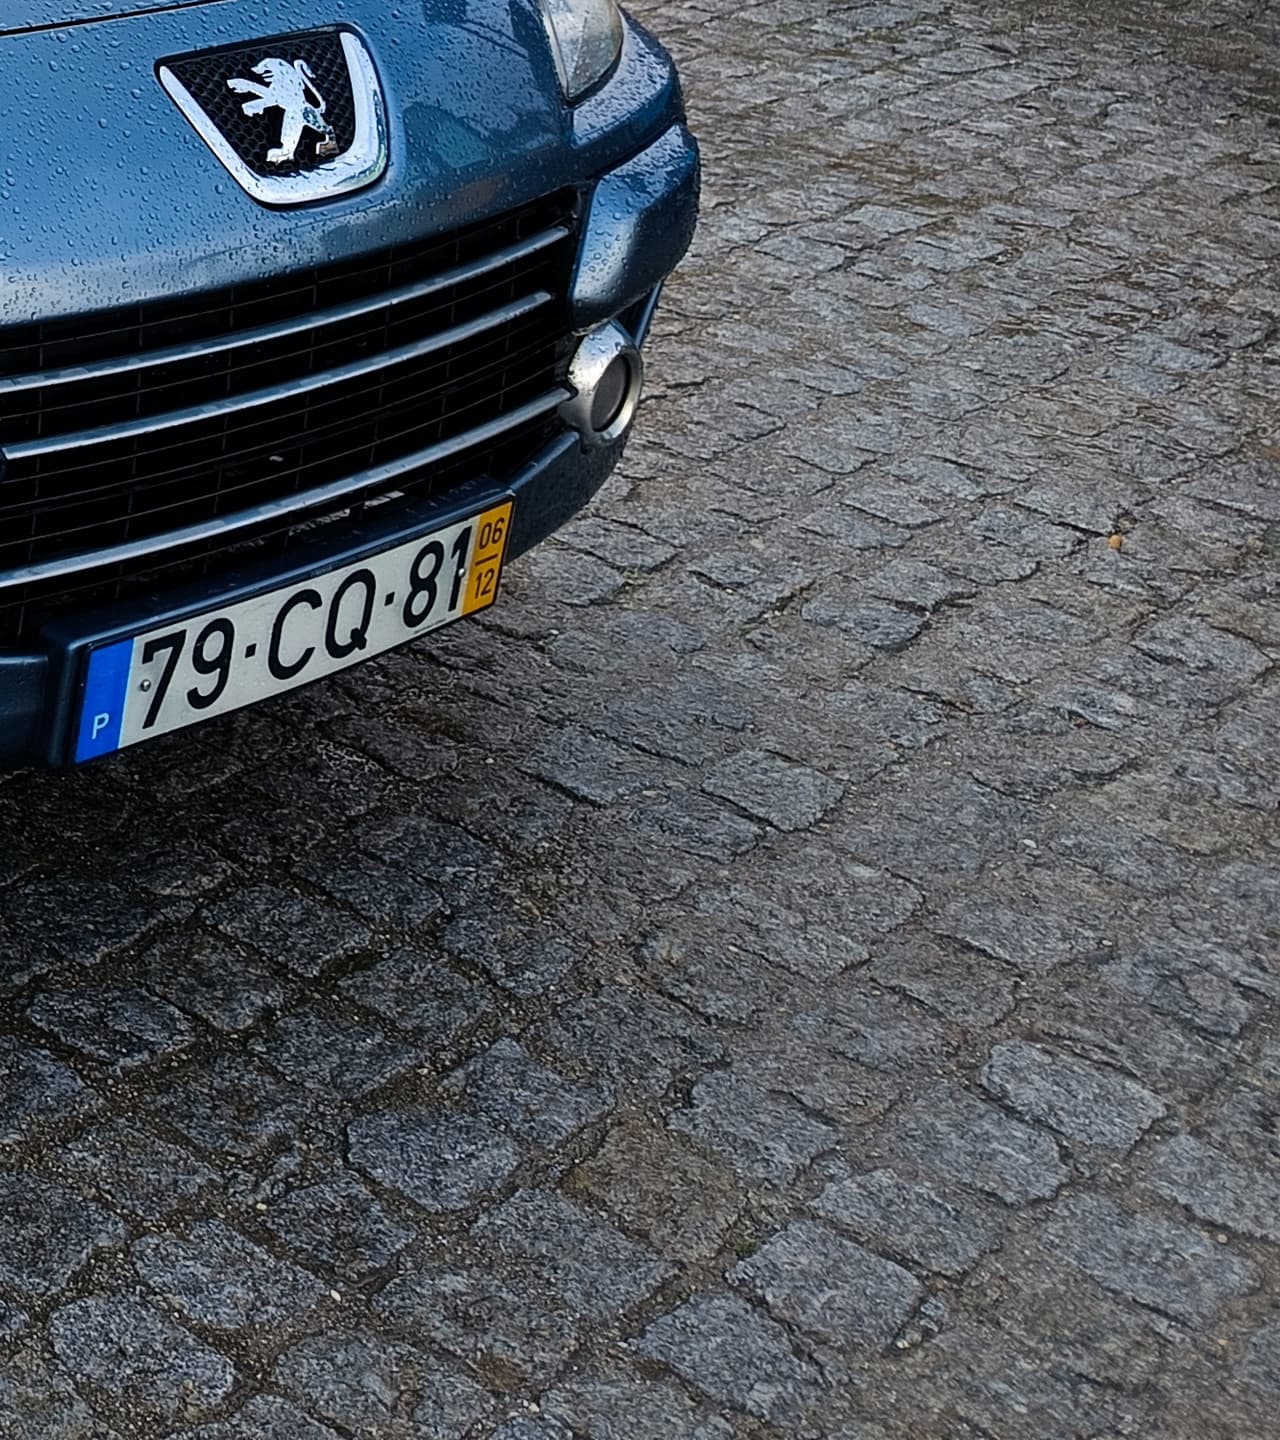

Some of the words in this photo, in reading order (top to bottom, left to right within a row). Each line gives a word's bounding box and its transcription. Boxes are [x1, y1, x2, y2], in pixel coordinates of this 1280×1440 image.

[478, 517, 505, 550] 06
[474, 567, 495, 600] 12
[91, 712, 110, 740] P
